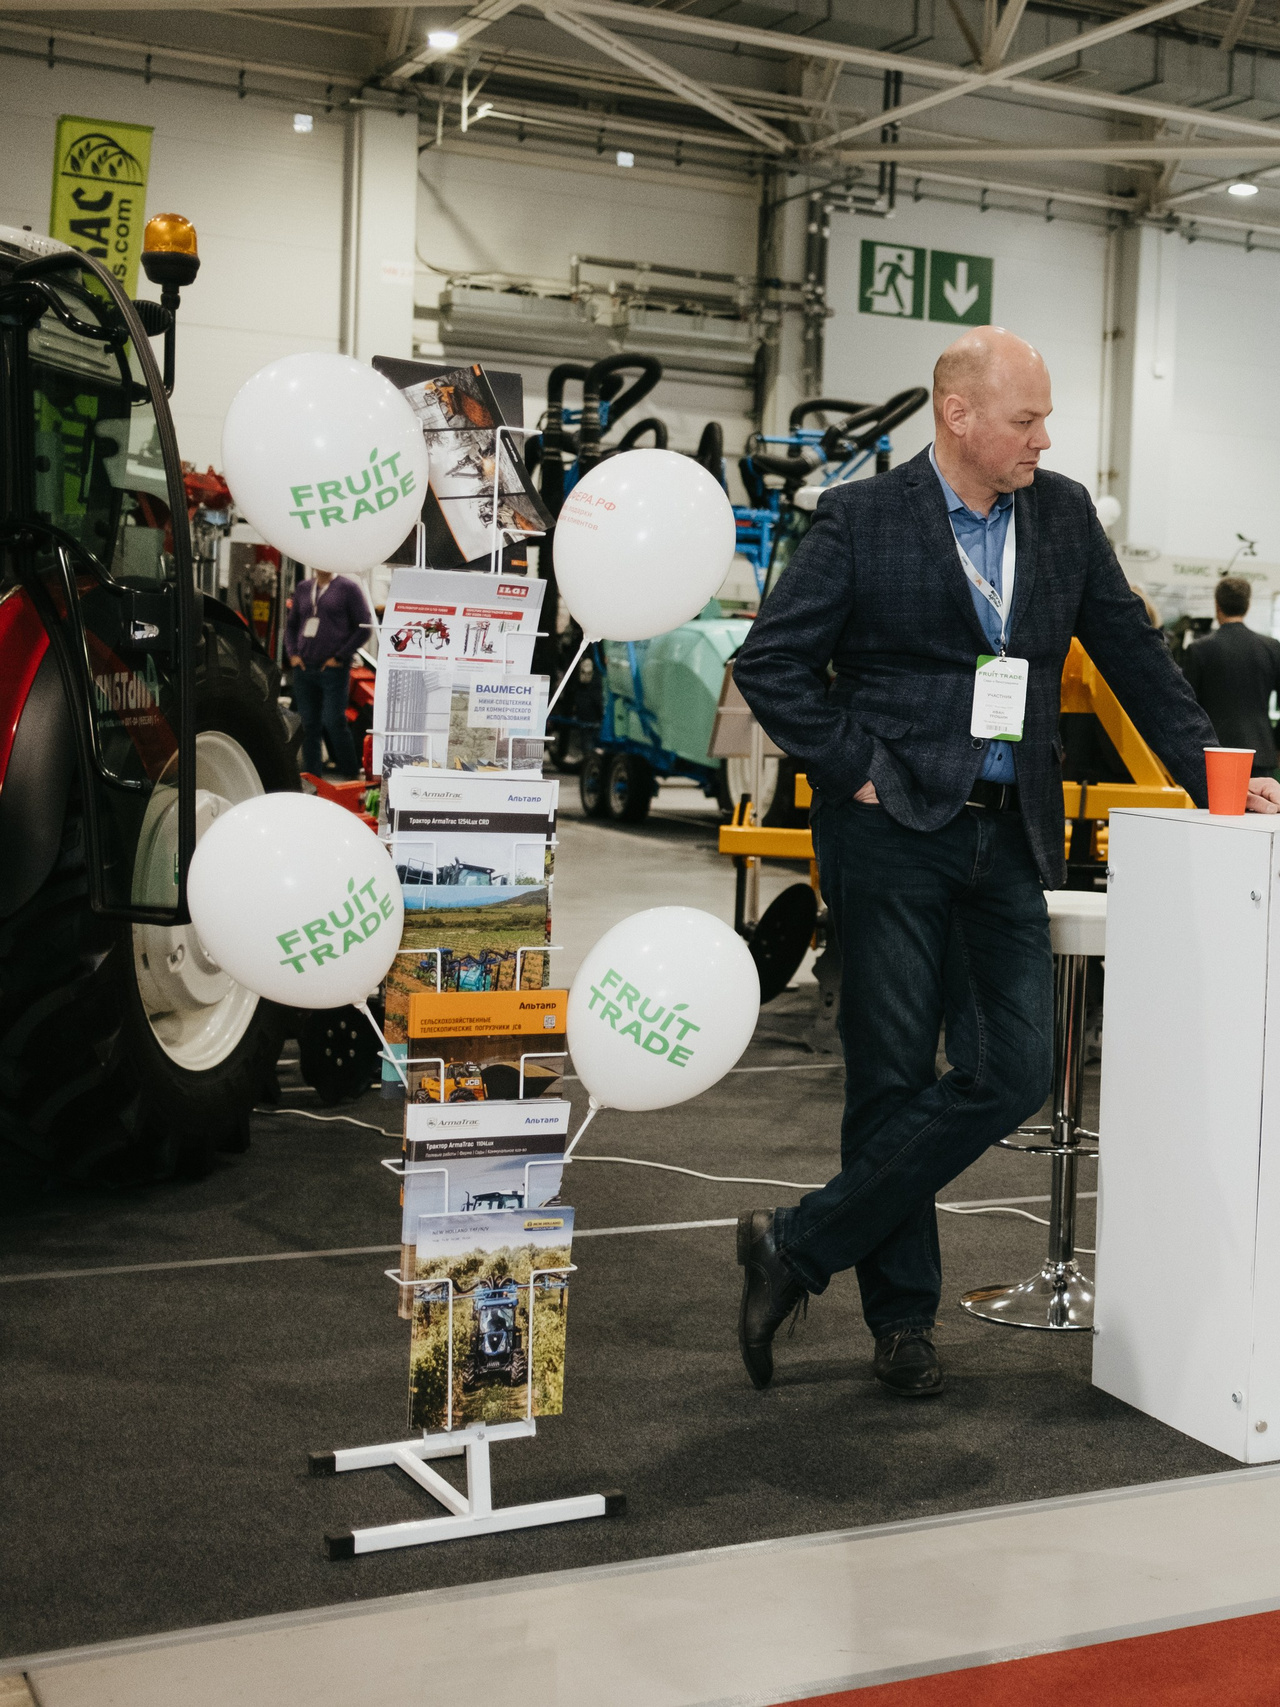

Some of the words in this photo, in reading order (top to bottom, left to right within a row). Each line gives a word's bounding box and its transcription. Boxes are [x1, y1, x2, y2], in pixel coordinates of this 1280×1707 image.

[289, 447, 401, 507] FRUIT
[289, 470, 417, 530] TRADE
[498, 586, 527, 596] ILGI
[476, 684, 532, 695] BAUMECH
[422, 790, 463, 799] ArmaTrac
[508, 795, 542, 803] Альтаир
[409, 817, 431, 825] Трактор
[276, 877, 378, 955] FRUIT
[279, 893, 394, 974] TRADE
[519, 1002, 557, 1010] Альтаир
[600, 968, 700, 1041] FRUIT
[420, 1017, 492, 1025] СЕЛЬСКОХОЗЯЙСТВЕННЫЕ
[588, 985, 694, 1067] TRADE
[465, 1078, 480, 1086] JCB
[438, 1118, 479, 1126] ArmaTrac
[525, 1116, 560, 1125] Альтаир
[426, 1142, 448, 1151] Трактор
[448, 1140, 474, 1148] ArmaTrac
